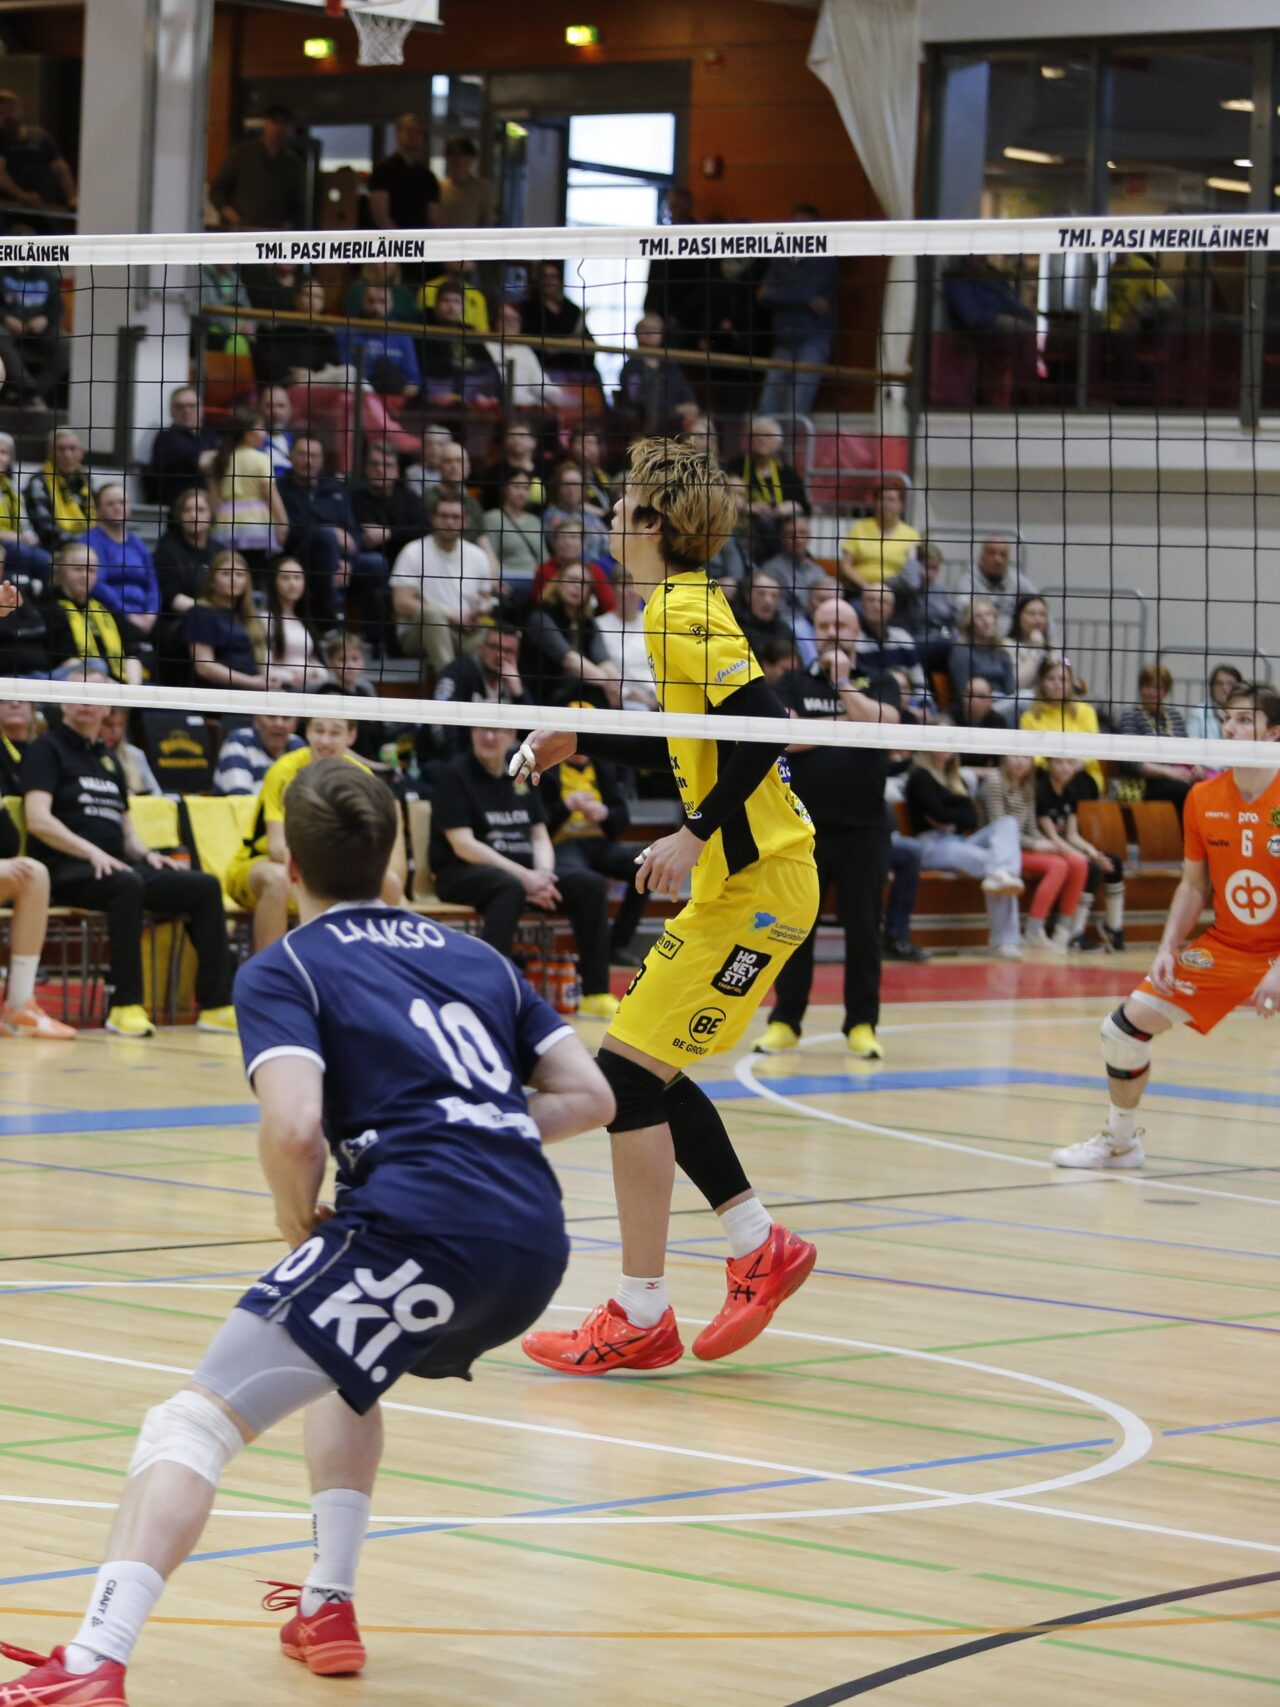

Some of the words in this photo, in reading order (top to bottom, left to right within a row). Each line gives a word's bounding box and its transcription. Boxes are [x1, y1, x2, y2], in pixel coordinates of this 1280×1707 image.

[256, 242, 287, 259] TMI.
[290, 242, 326, 259] PASI
[329, 236, 425, 259] MERILÄINEN
[639, 238, 673, 256] TMI.
[678, 237, 717, 255] PASI
[721, 232, 827, 254] MERILÄINEN
[1058, 228, 1095, 248] TMI.
[1101, 228, 1145, 248] PASI
[1149, 225, 1269, 248] MERILÄINEN
[1241, 829, 1254, 857] 6
[324, 918, 446, 949] LAAKSO
[735, 950, 758, 964] HO
[721, 971, 749, 987] STY
[729, 961, 759, 978] NEY
[692, 1015, 723, 1035] BE
[409, 998, 513, 1094] 10
[672, 1037, 684, 1049] BE
[101, 1579, 118, 1616] CRAFT
